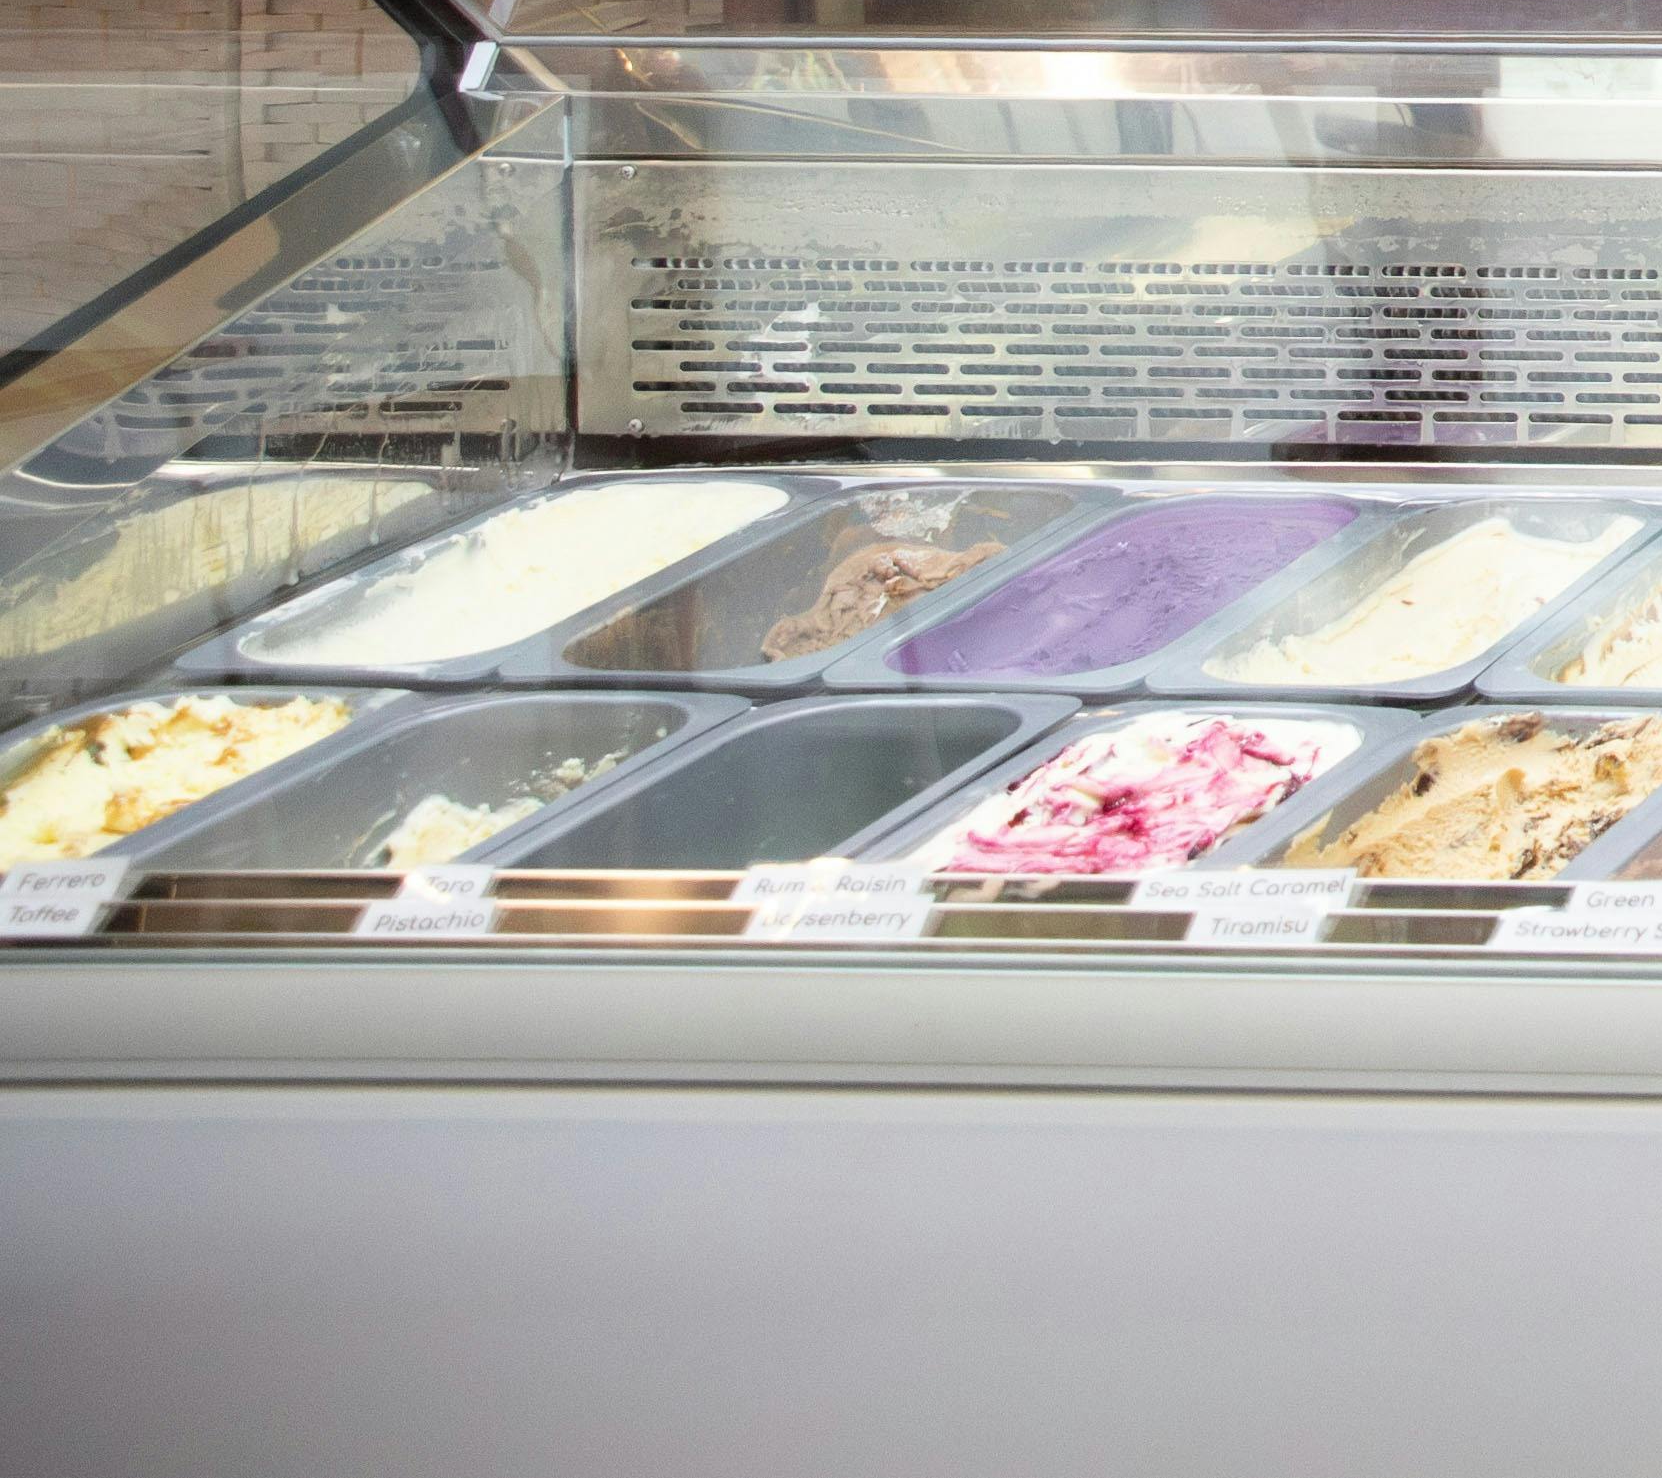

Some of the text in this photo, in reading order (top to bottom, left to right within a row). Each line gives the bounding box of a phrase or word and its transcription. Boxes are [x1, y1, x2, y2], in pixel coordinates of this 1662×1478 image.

[17, 872, 106, 891] Ferrero
[754, 876, 806, 894] Rum
[834, 875, 907, 893] Raisin
[1145, 874, 1348, 898] Sea Salt Caramel
[1586, 890, 1655, 908] Green
[9, 904, 80, 923] Toffee
[374, 909, 486, 933] Pistachio
[1210, 916, 1310, 935] Tiramisu
[1514, 919, 1648, 943] Strawberry
